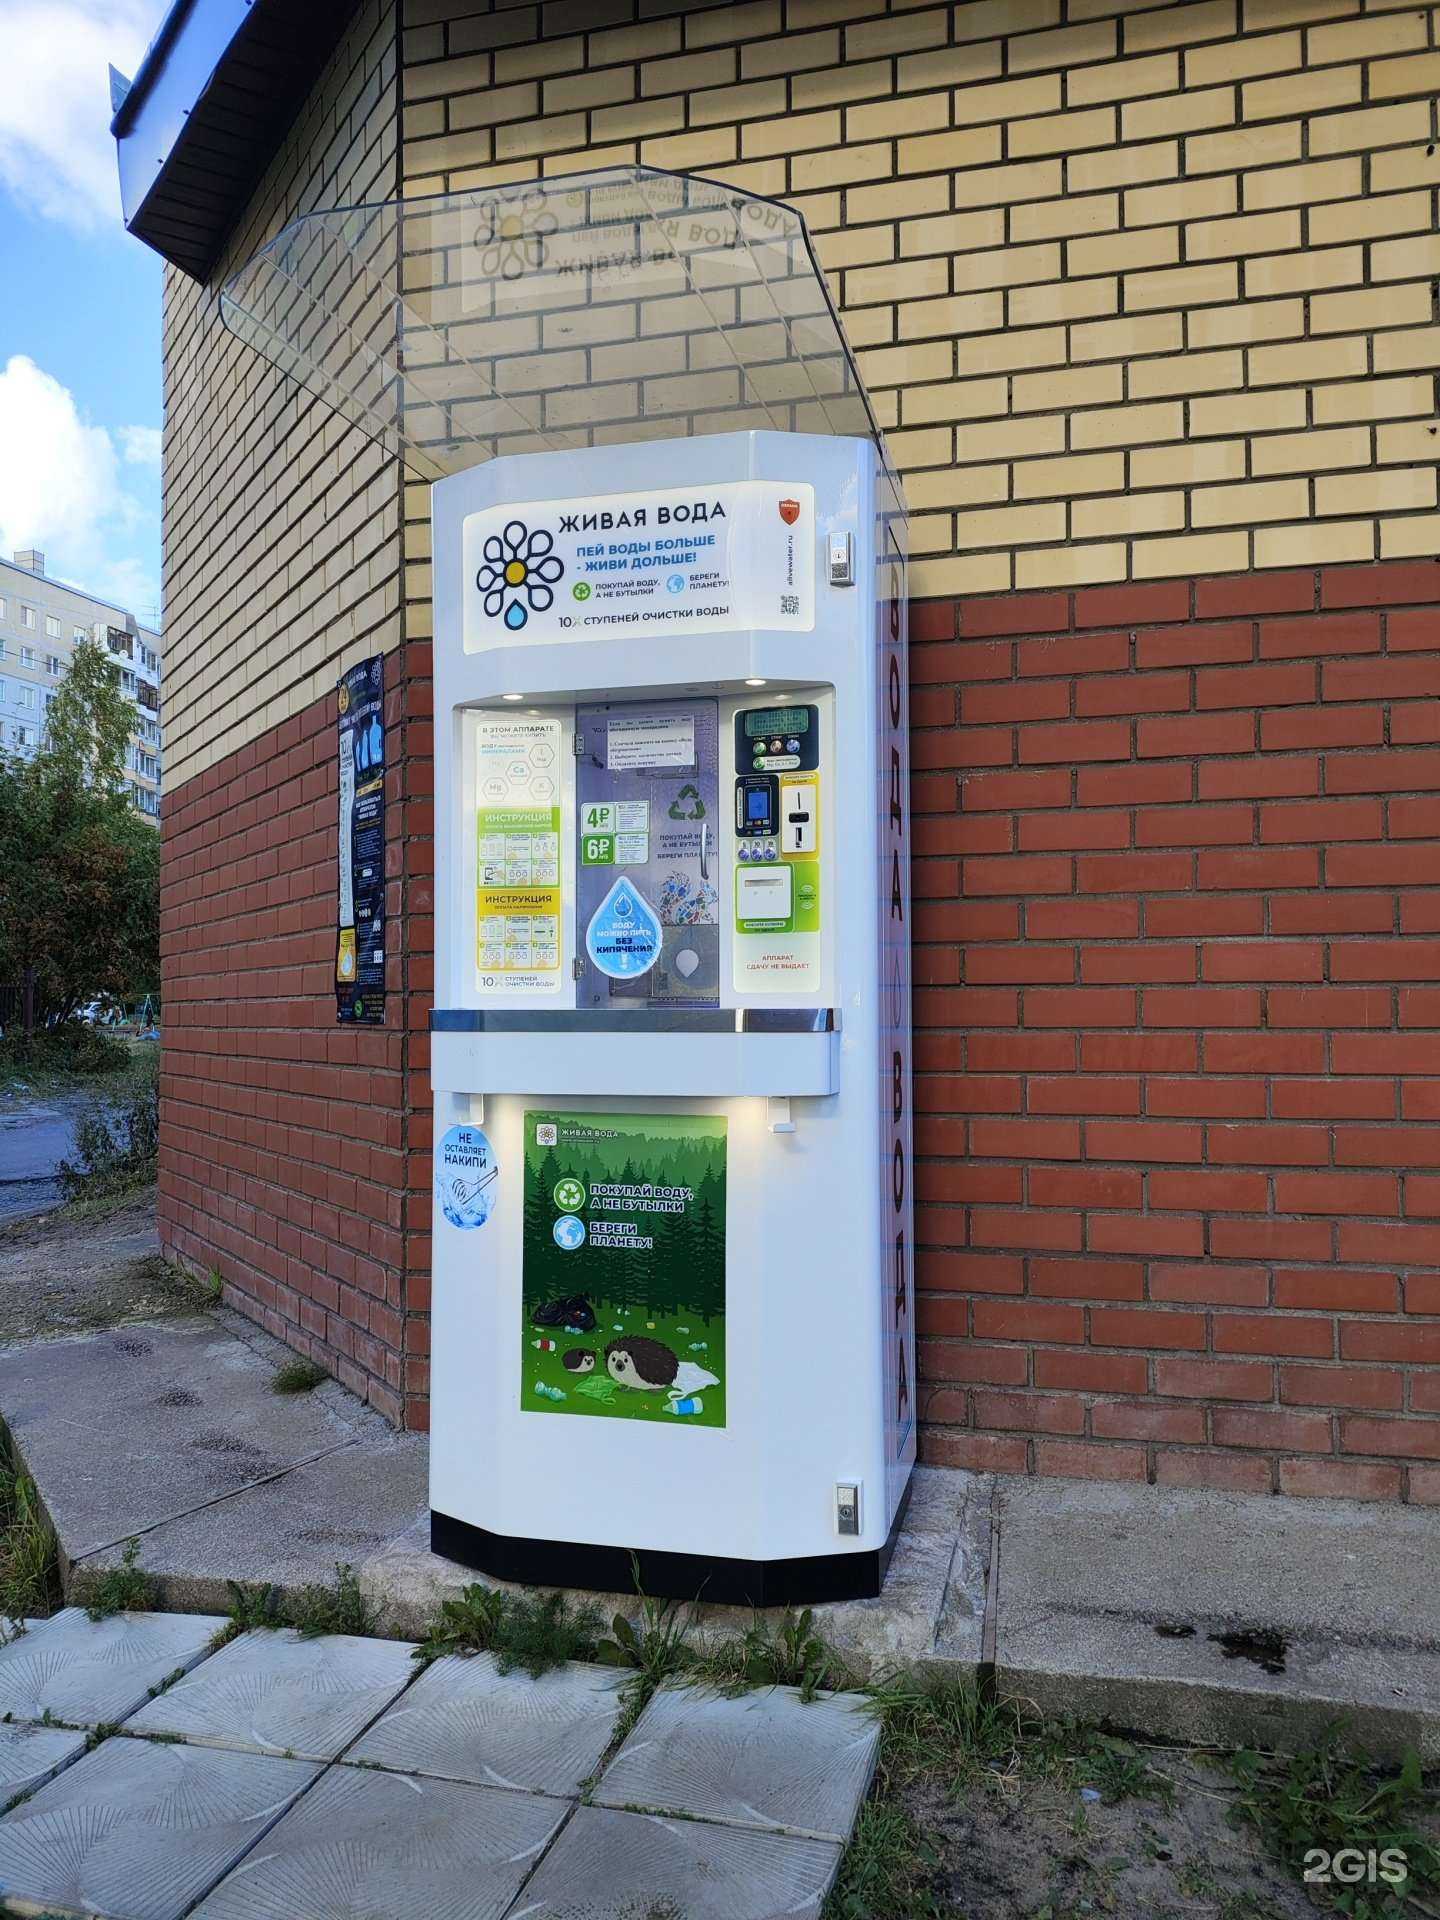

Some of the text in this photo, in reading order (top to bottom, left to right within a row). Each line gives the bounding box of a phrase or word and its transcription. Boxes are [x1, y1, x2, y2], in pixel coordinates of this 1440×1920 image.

[558, 501, 726, 533] ЖИВАЯ ВОДА
[576, 535, 715, 557] ПЕЙ ВОДЫ БОЛЬШЕ
[585, 558, 627, 572] ЖИВИ
[631, 552, 697, 570] ДОЛЬШЕ!
[689, 572, 720, 582] БЕРЕГИ
[595, 580, 634, 590] ПОКУПАЙ
[615, 588, 654, 597] БУТЫЛКИ
[584, 613, 640, 625] СТУПЕНЕЙ
[642, 609, 693, 621] ОЧИСТКИ
[696, 606, 730, 617] ВОДЫ
[513, 725, 554, 733] АППАРАТЕ
[485, 813, 552, 823] ИНСТРУКЦИЯ
[485, 895, 552, 904] ИНСТРУКЦИЯ
[612, 921, 635, 930] ВОДУ
[615, 937, 633, 945] БЕЗ
[596, 945, 653, 954] КИПЯЧЕНИЯ
[459, 1132, 472, 1144] НЕ
[561, 1129, 618, 1138] ЖИВАЯ ВОДА
[444, 1144, 487, 1156] ОСТАВЛЯЕТ
[444, 1153, 487, 1169] НАКИПИ
[590, 1183, 694, 1200] ПОКУПАЙ ВОДУ,
[591, 1198, 684, 1213] А НЕ БУТЫЛКИ
[590, 1222, 637, 1235] БЕРЕГИ
[590, 1234, 653, 1249] ПЛАНЕТУ!
